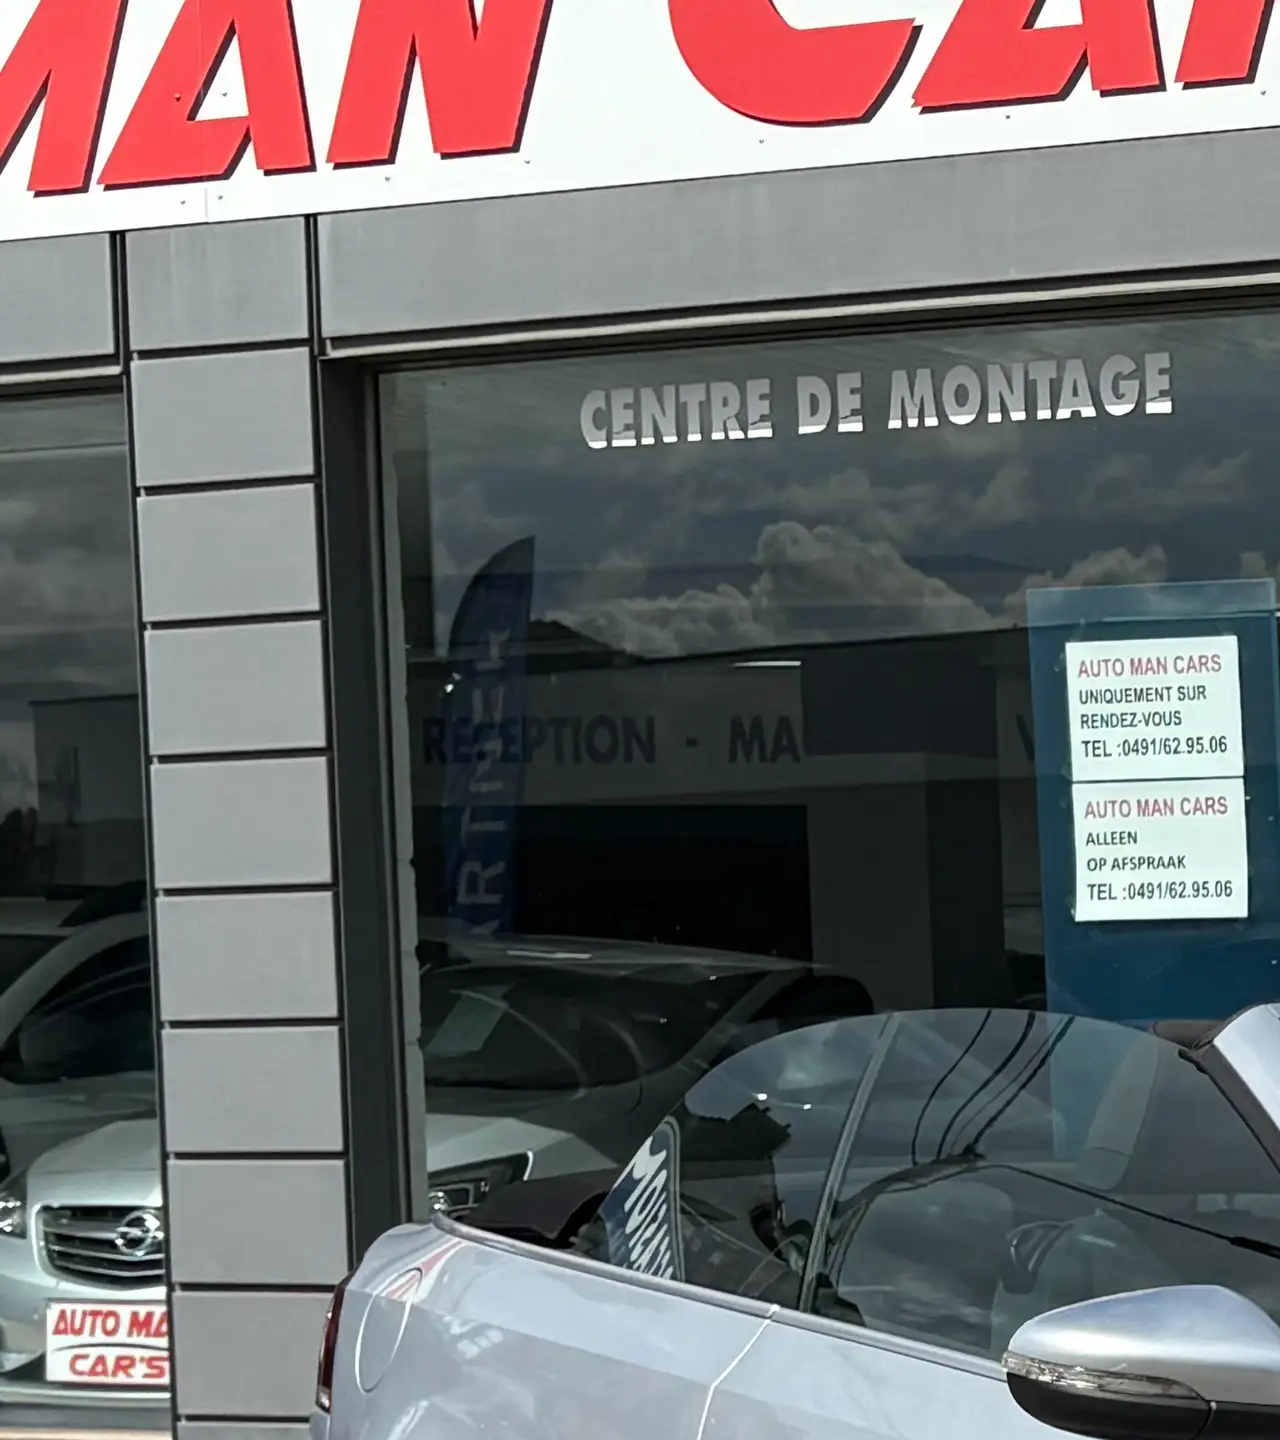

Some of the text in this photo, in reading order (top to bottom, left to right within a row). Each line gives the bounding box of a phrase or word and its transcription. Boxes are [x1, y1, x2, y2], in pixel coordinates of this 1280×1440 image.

[580, 352, 1173, 448] CENTRE DE MONTAGE
[1078, 654, 1222, 678] AUTO MAN CARS
[1079, 685, 1207, 704] UNIQUEMENT SUR
[1081, 711, 1182, 729] RENDEZ-VOUS
[1082, 740, 1112, 758] TEL
[1085, 796, 1228, 819] AUTO MAN CARS
[1086, 831, 1138, 846] ALLEEN
[1087, 855, 1186, 871] OP AFSPRAAK
[1087, 884, 1117, 901] TEL
[52, 1309, 168, 1338] AUTO MA
[69, 1353, 168, 1379] CAR'S
